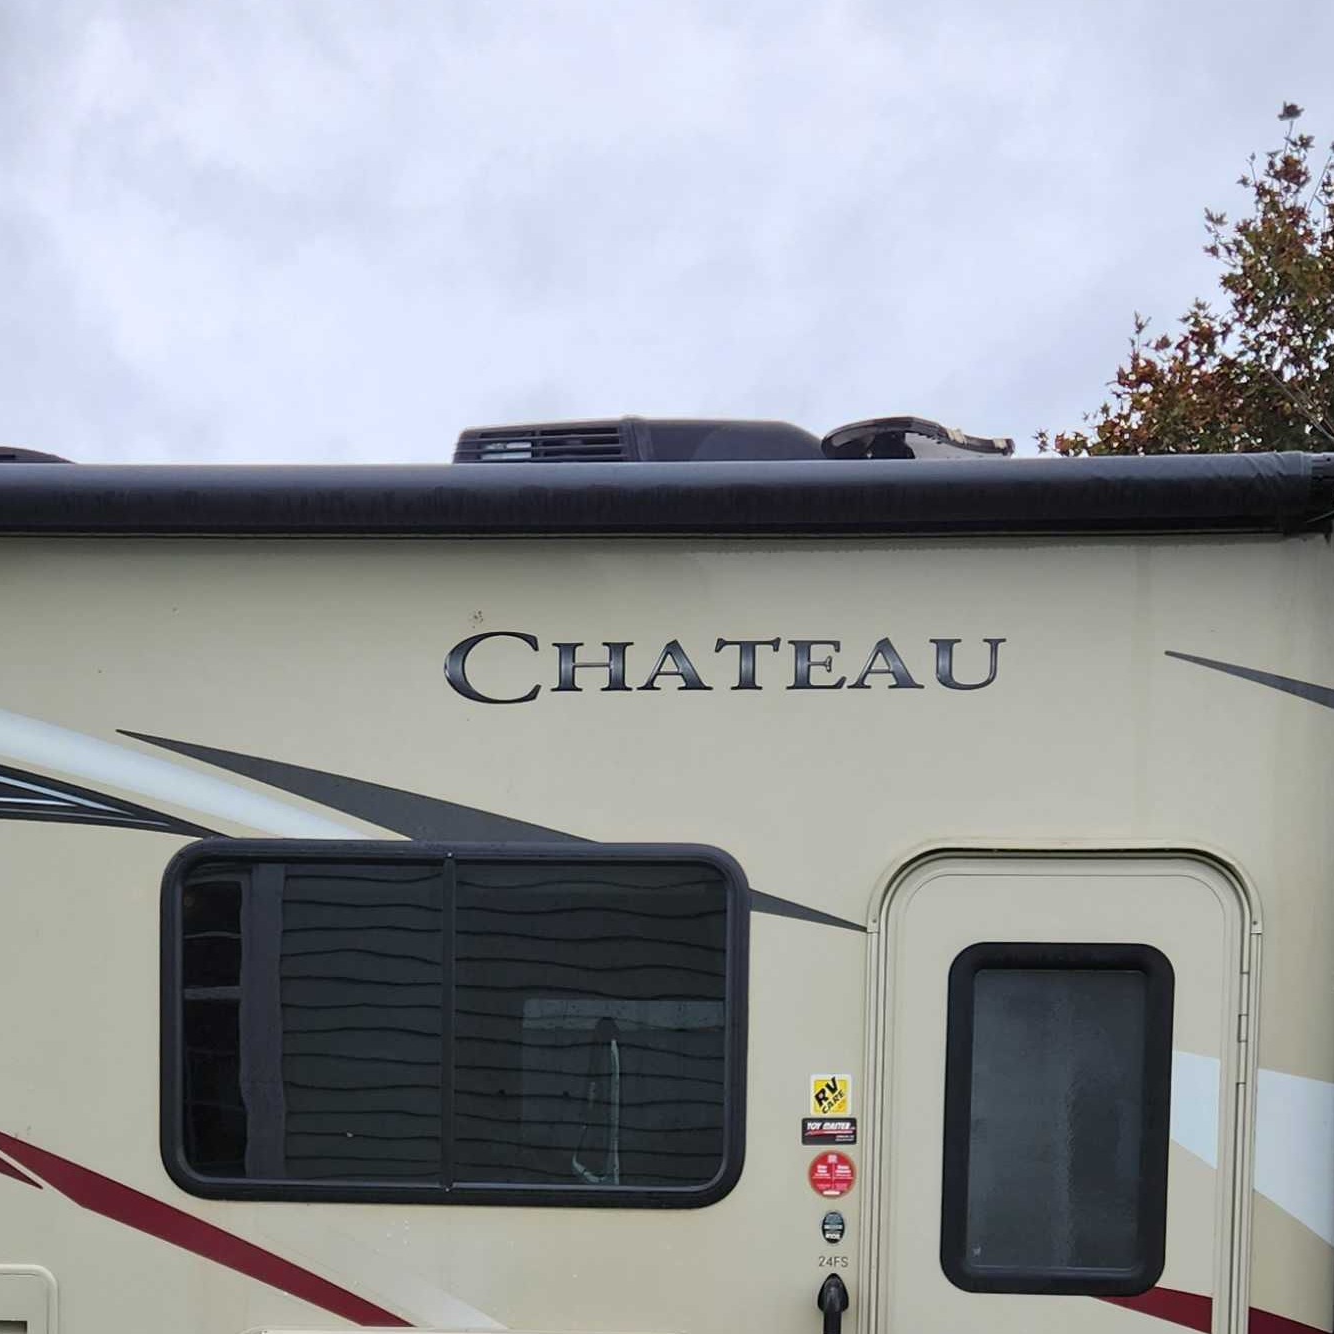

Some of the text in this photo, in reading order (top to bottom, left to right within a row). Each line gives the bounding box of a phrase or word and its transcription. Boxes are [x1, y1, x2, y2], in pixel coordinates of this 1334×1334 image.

[443, 631, 1007, 704] CHATEAU
[814, 1076, 838, 1108] RV
[822, 1089, 845, 1114] CARE
[818, 1255, 849, 1268] 24FS
